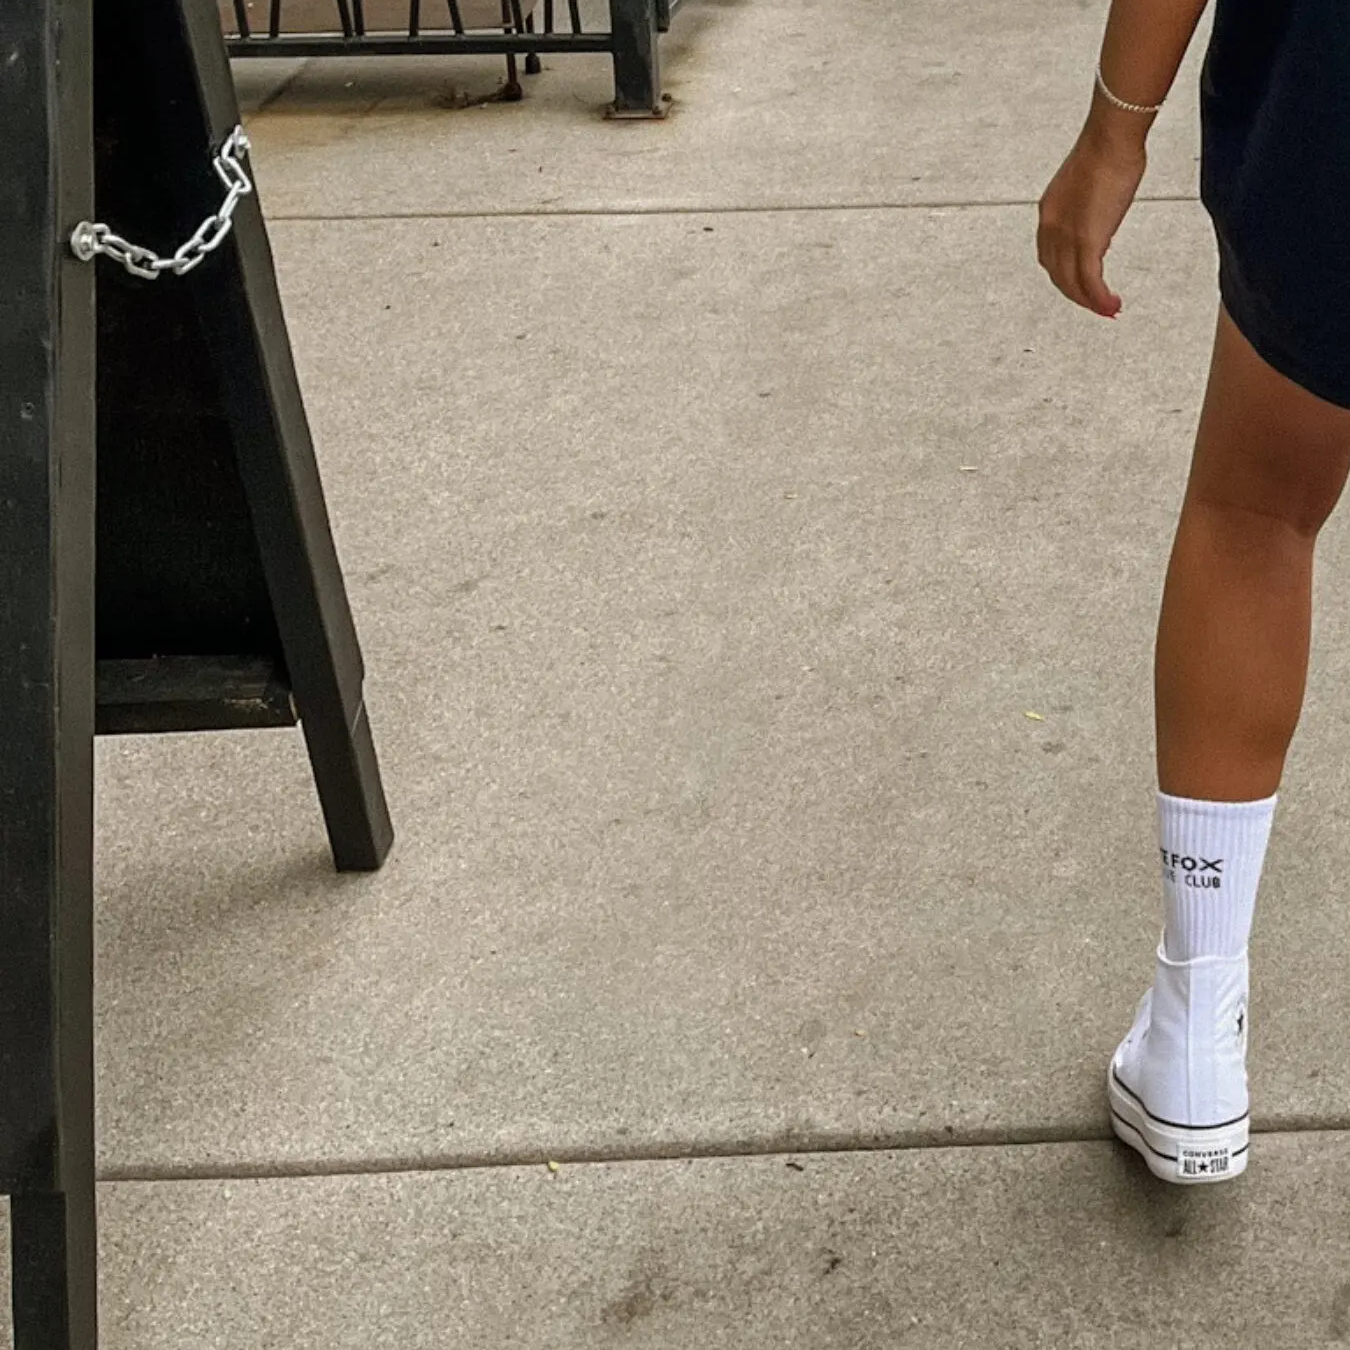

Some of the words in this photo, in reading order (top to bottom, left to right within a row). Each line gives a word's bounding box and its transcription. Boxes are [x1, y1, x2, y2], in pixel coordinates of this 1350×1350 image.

[1184, 874, 1221, 888] CLUB
[1183, 1159, 1197, 1174] ALL
[1210, 1156, 1229, 1173] STAR
